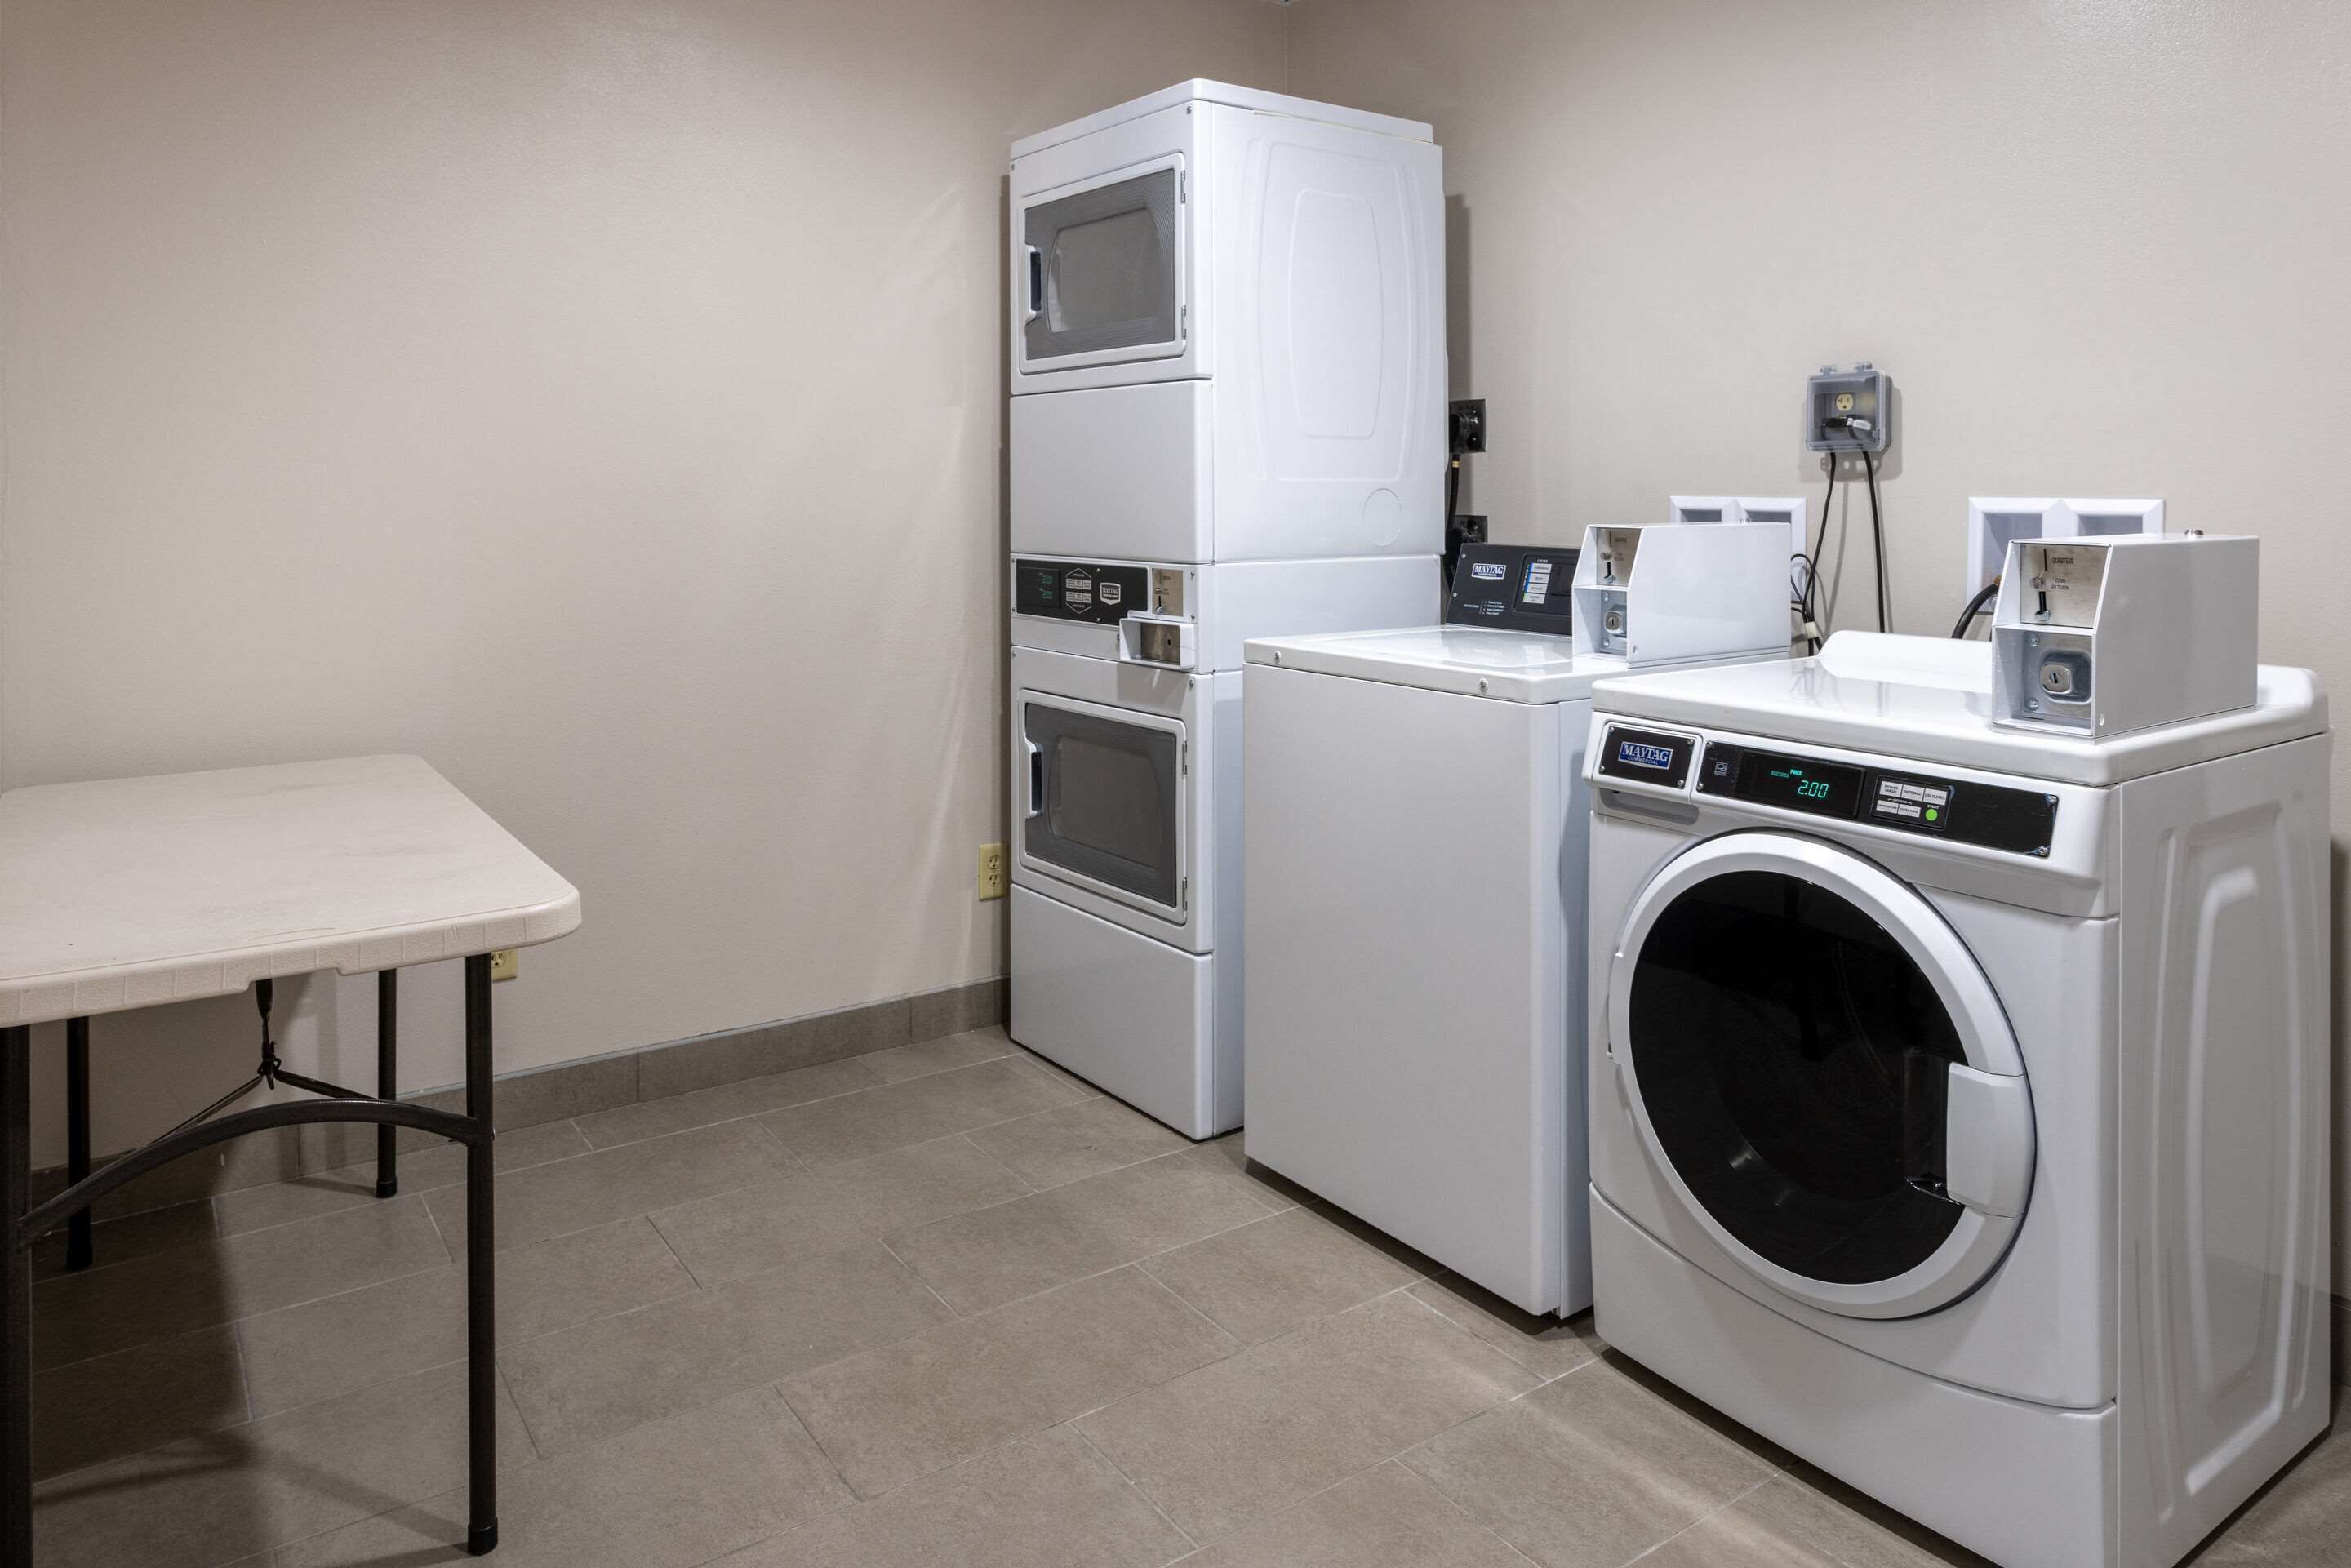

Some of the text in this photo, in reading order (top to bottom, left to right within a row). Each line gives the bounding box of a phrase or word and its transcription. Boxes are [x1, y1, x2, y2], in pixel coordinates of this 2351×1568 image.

[1474, 565, 1504, 574] MAYTAG
[1621, 744, 1669, 762] MAYTAG
[1628, 756, 1660, 765] COMMERCIAL
[1798, 780, 1829, 798] 2.00
